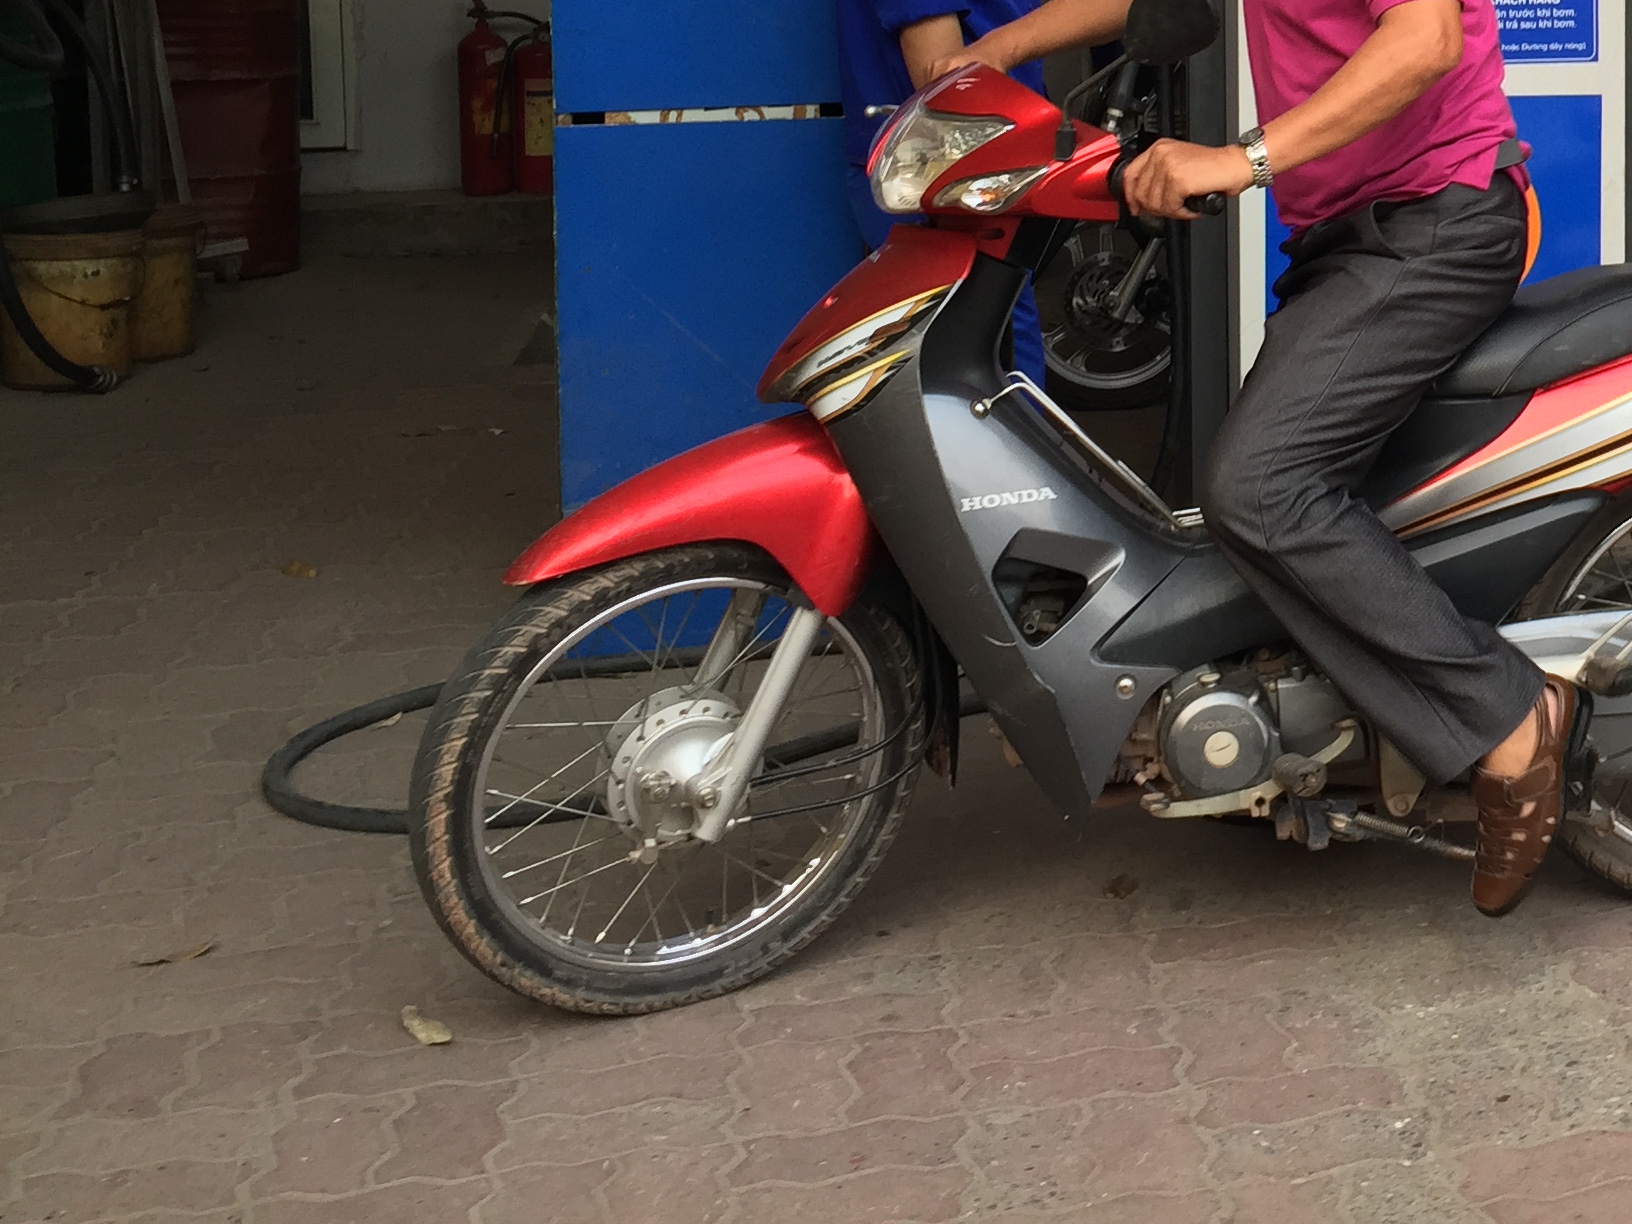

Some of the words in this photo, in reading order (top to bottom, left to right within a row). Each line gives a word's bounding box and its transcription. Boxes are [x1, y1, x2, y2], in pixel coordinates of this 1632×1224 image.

[1537, 7, 1551, 17] khi
[1538, 19, 1552, 29] khi
[961, 485, 1058, 513] HONDA
